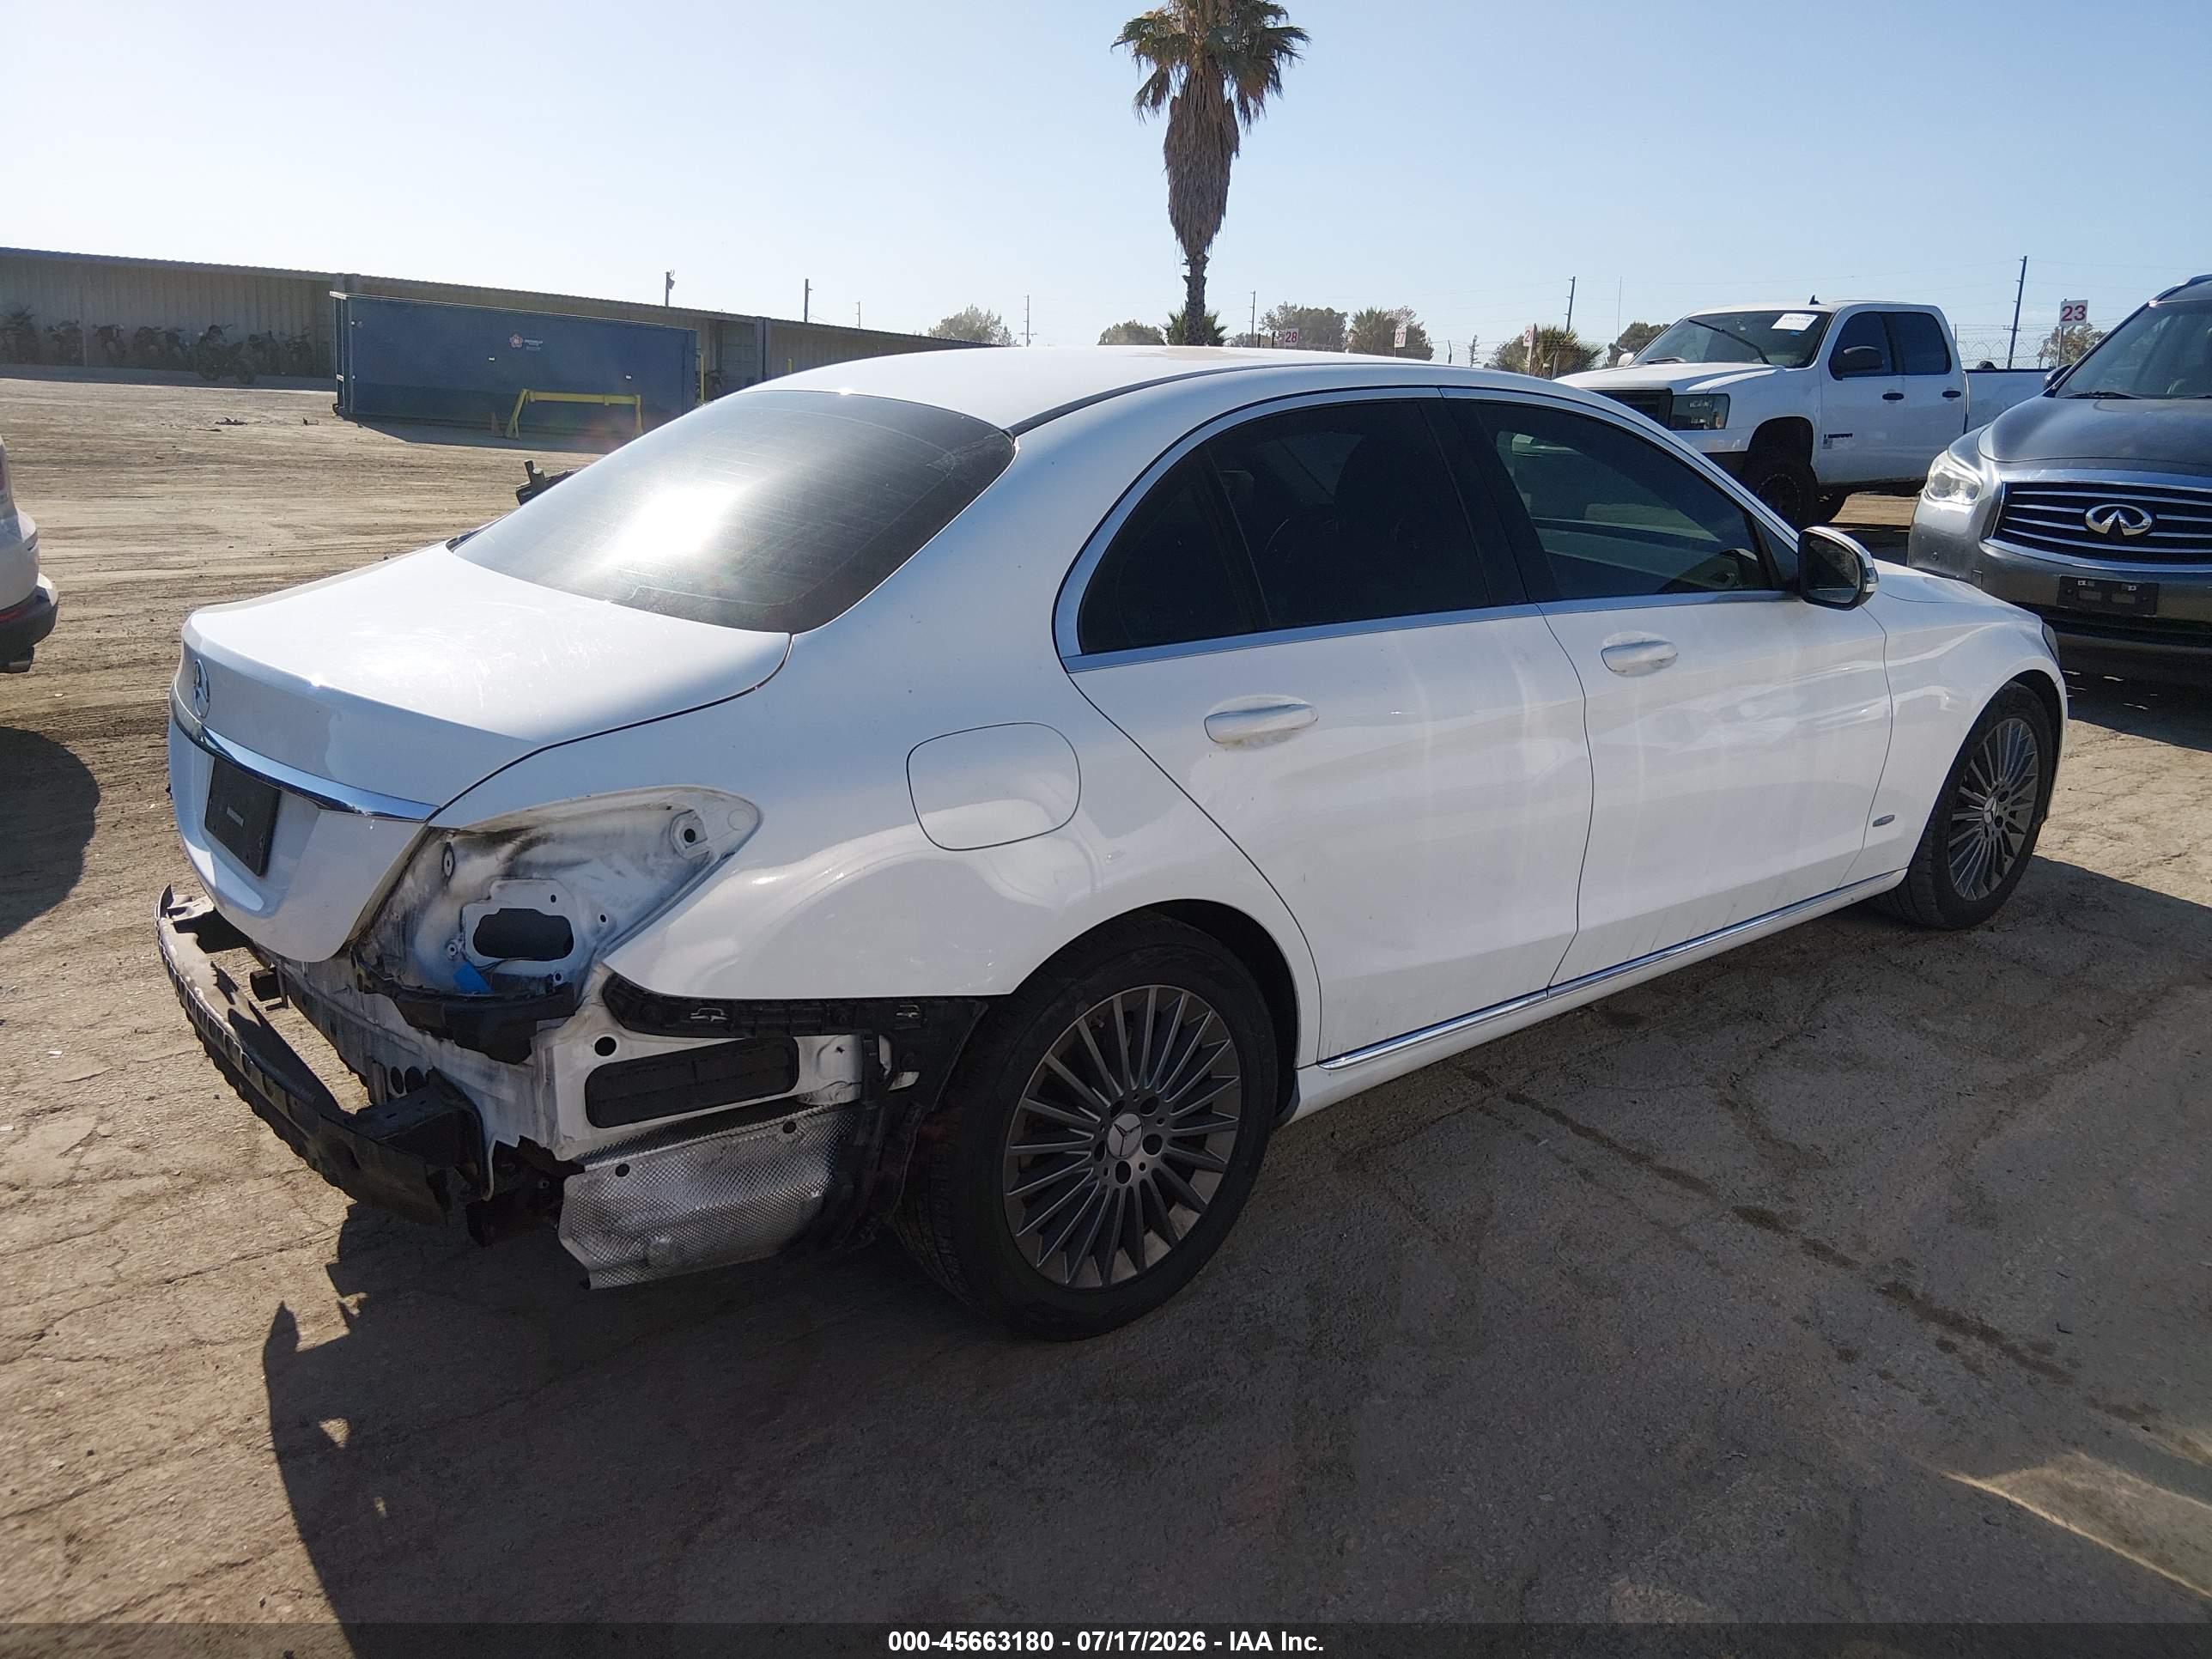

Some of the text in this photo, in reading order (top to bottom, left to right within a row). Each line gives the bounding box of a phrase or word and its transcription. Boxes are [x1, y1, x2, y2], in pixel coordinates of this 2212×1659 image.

[2061, 304, 2086, 322] 23
[1285, 331, 1297, 343] 28
[1395, 331, 1406, 344] 27
